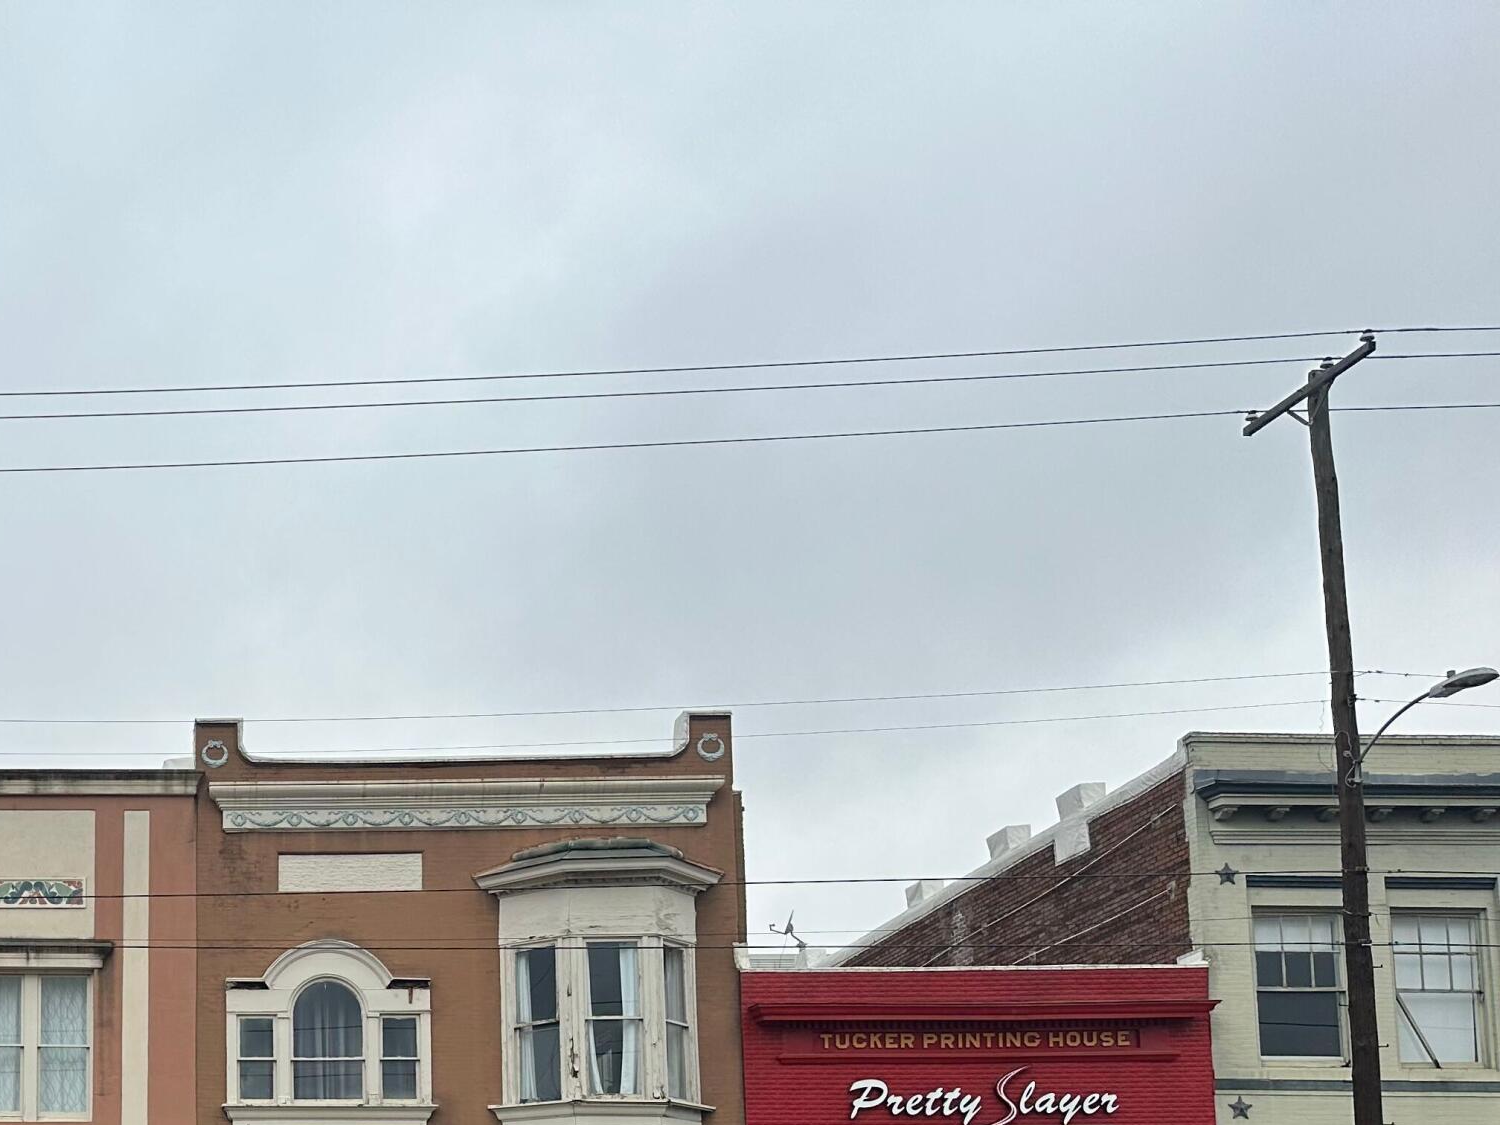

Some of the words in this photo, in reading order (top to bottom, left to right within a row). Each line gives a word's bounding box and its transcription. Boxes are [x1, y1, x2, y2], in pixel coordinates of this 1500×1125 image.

[819, 1032, 915, 1049] TUCKER
[923, 1031, 1041, 1048] PRINTING
[1049, 1030, 1131, 1047] HOUSE
[849, 1078, 982, 1125] Pretty
